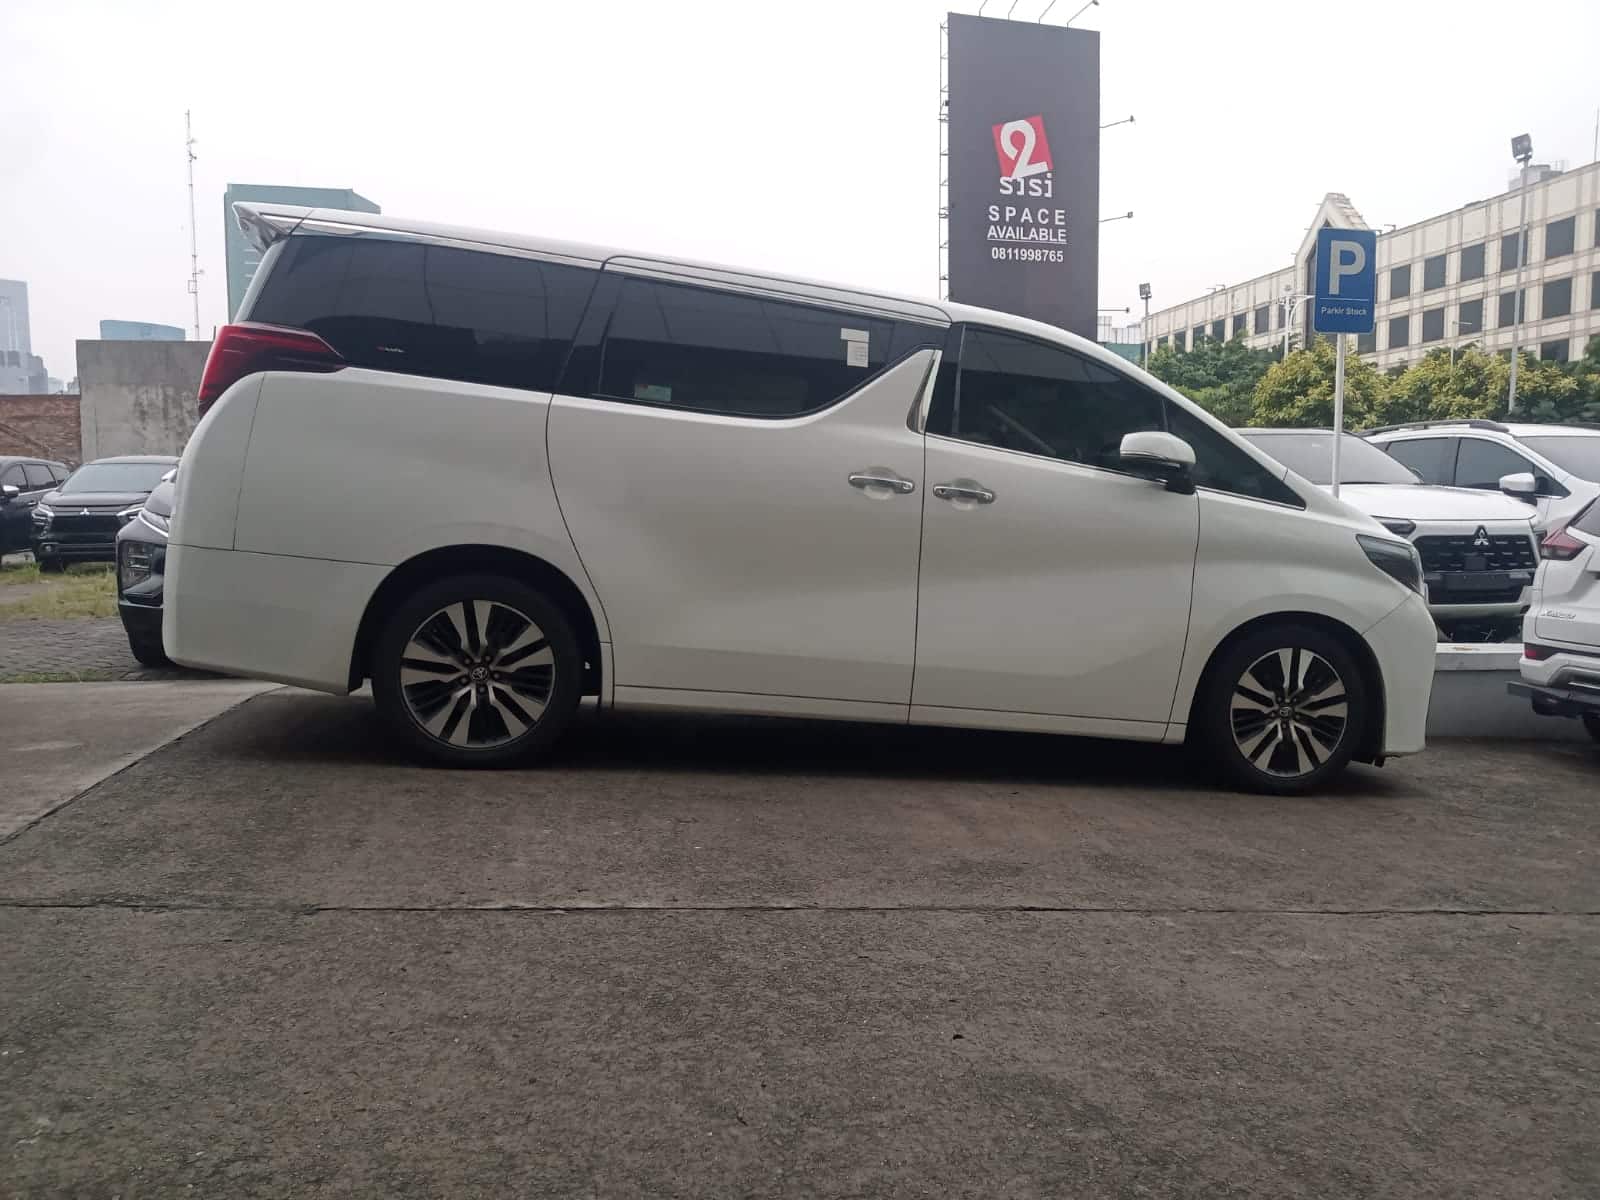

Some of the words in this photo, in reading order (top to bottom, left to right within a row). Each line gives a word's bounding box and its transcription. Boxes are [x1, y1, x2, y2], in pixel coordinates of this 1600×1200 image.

[1000, 119, 1049, 179] 2
[988, 205, 1066, 226] SPACE
[987, 225, 1067, 242] AVAILABLE
[991, 247, 1064, 263] 0811998765
[1328, 239, 1366, 295] P
